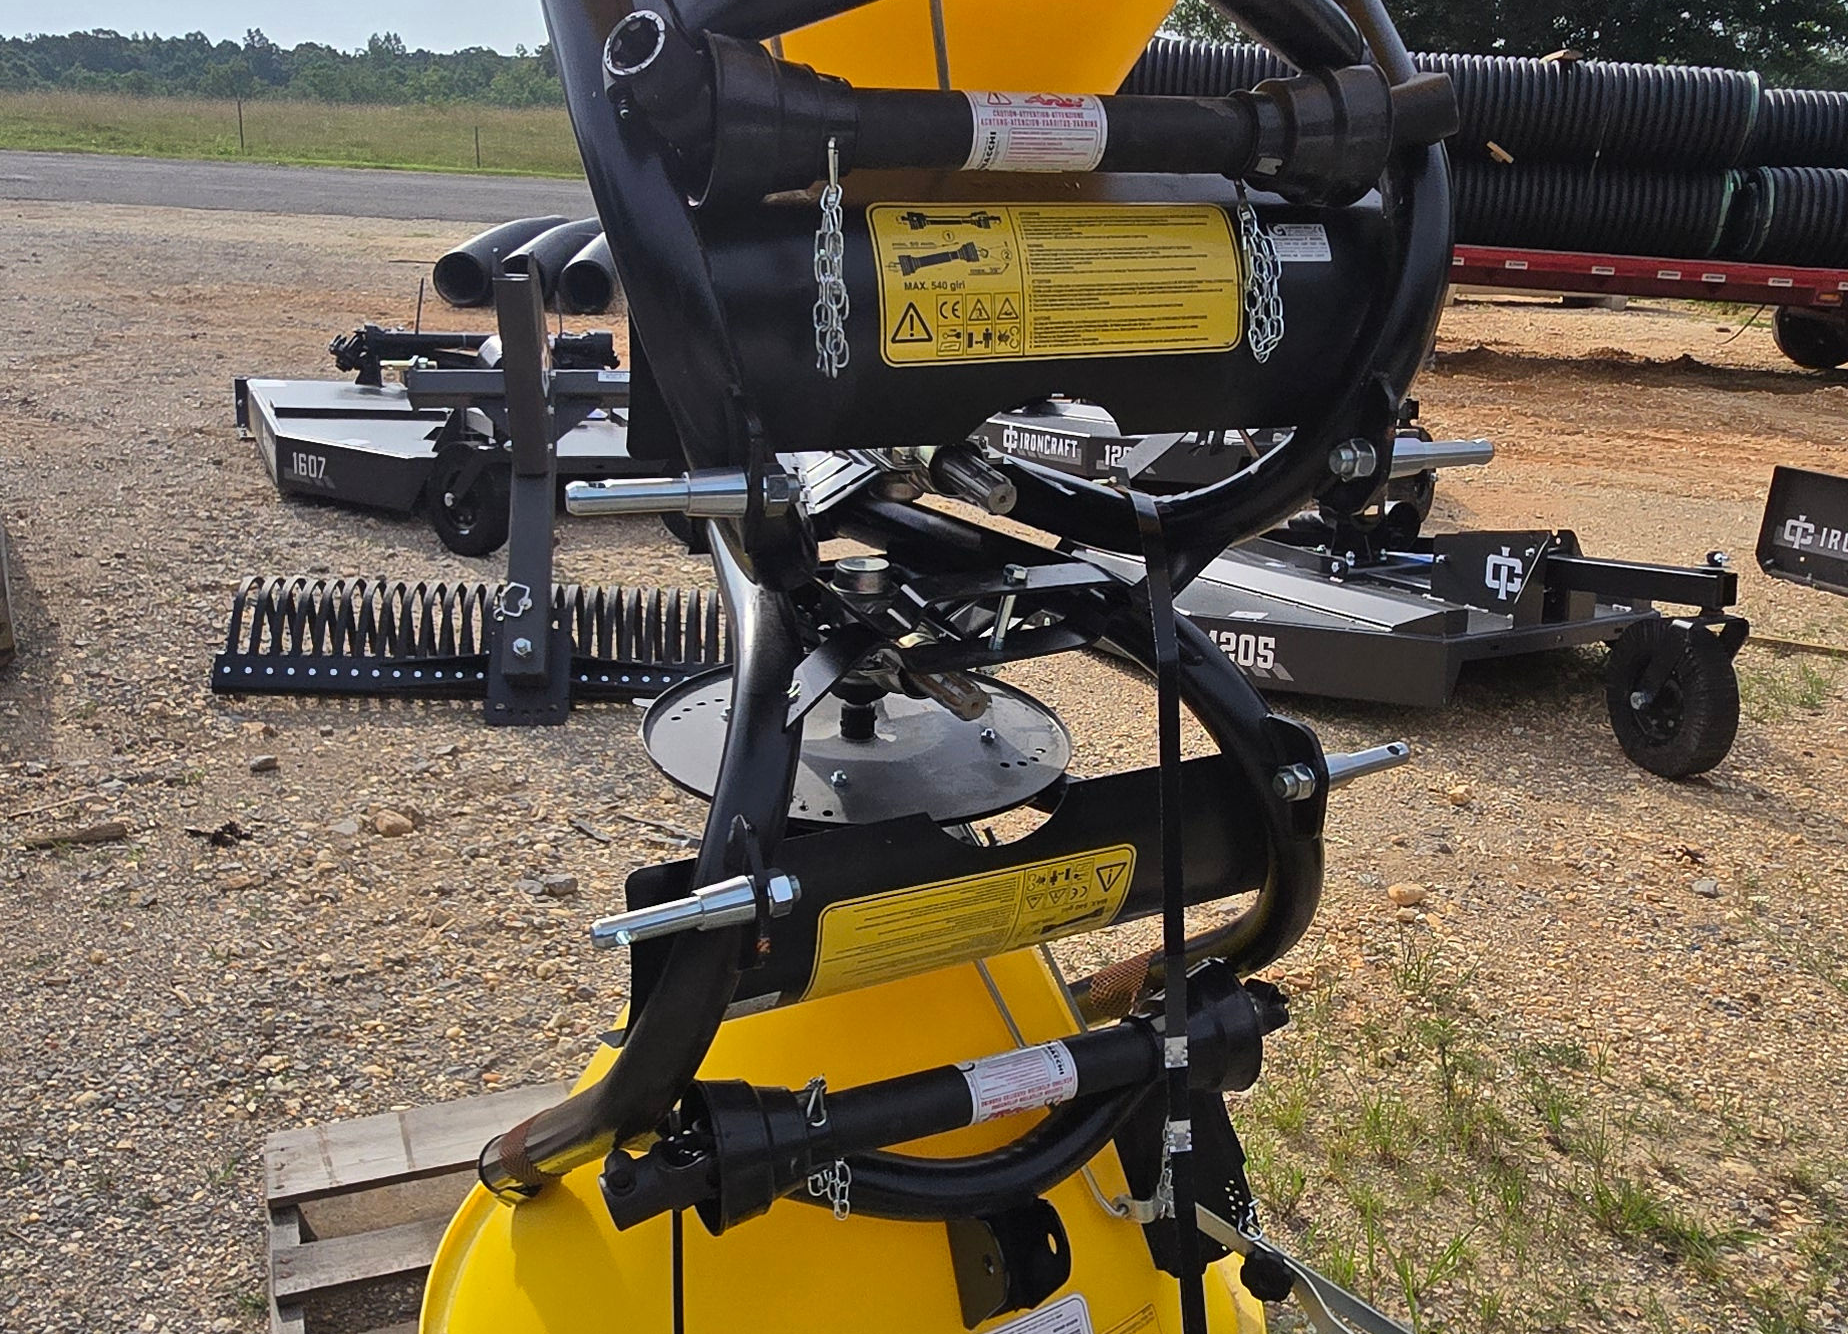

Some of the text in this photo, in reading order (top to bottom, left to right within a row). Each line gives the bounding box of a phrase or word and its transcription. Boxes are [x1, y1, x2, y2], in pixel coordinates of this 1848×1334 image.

[904, 280, 966, 292] MAX. 540 giri
[1020, 432, 1078, 458] IRONCRAFT
[293, 451, 326, 479] 1607
